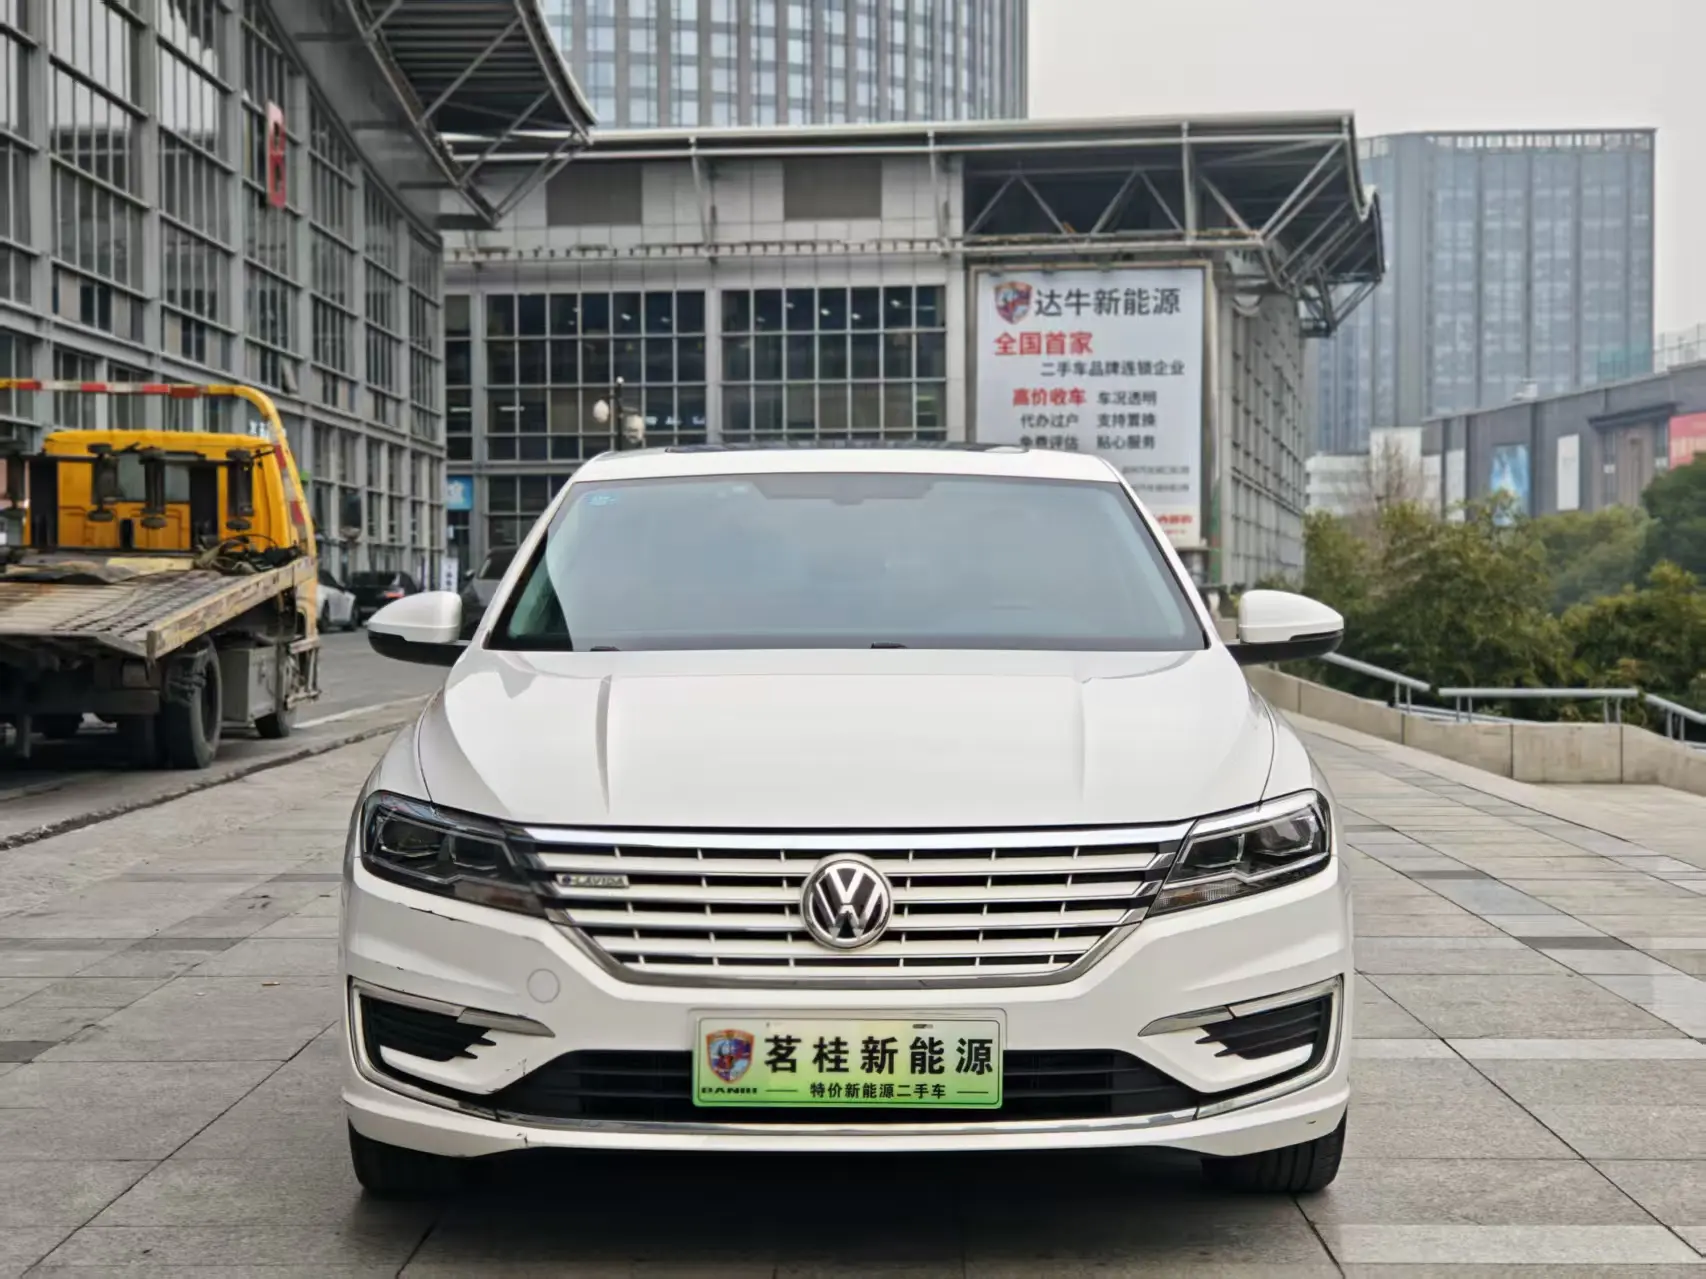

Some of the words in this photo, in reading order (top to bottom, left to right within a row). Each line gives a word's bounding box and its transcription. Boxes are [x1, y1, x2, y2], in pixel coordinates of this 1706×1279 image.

[1034, 287, 1181, 316] 达牛新能源
[994, 332, 1093, 356] 全国首家
[1040, 360, 1185, 377] 二手车品牌连锁企业
[1012, 387, 1087, 407] 高价收车
[1096, 391, 1157, 406] 车况透明
[1020, 413, 1079, 428] 代办过户
[1096, 413, 1157, 428] 支持置换
[1096, 435, 1155, 449] 贴心服务
[764, 1034, 994, 1076] 茗桂新能源
[809, 1082, 946, 1099] 特价新能源二手车
